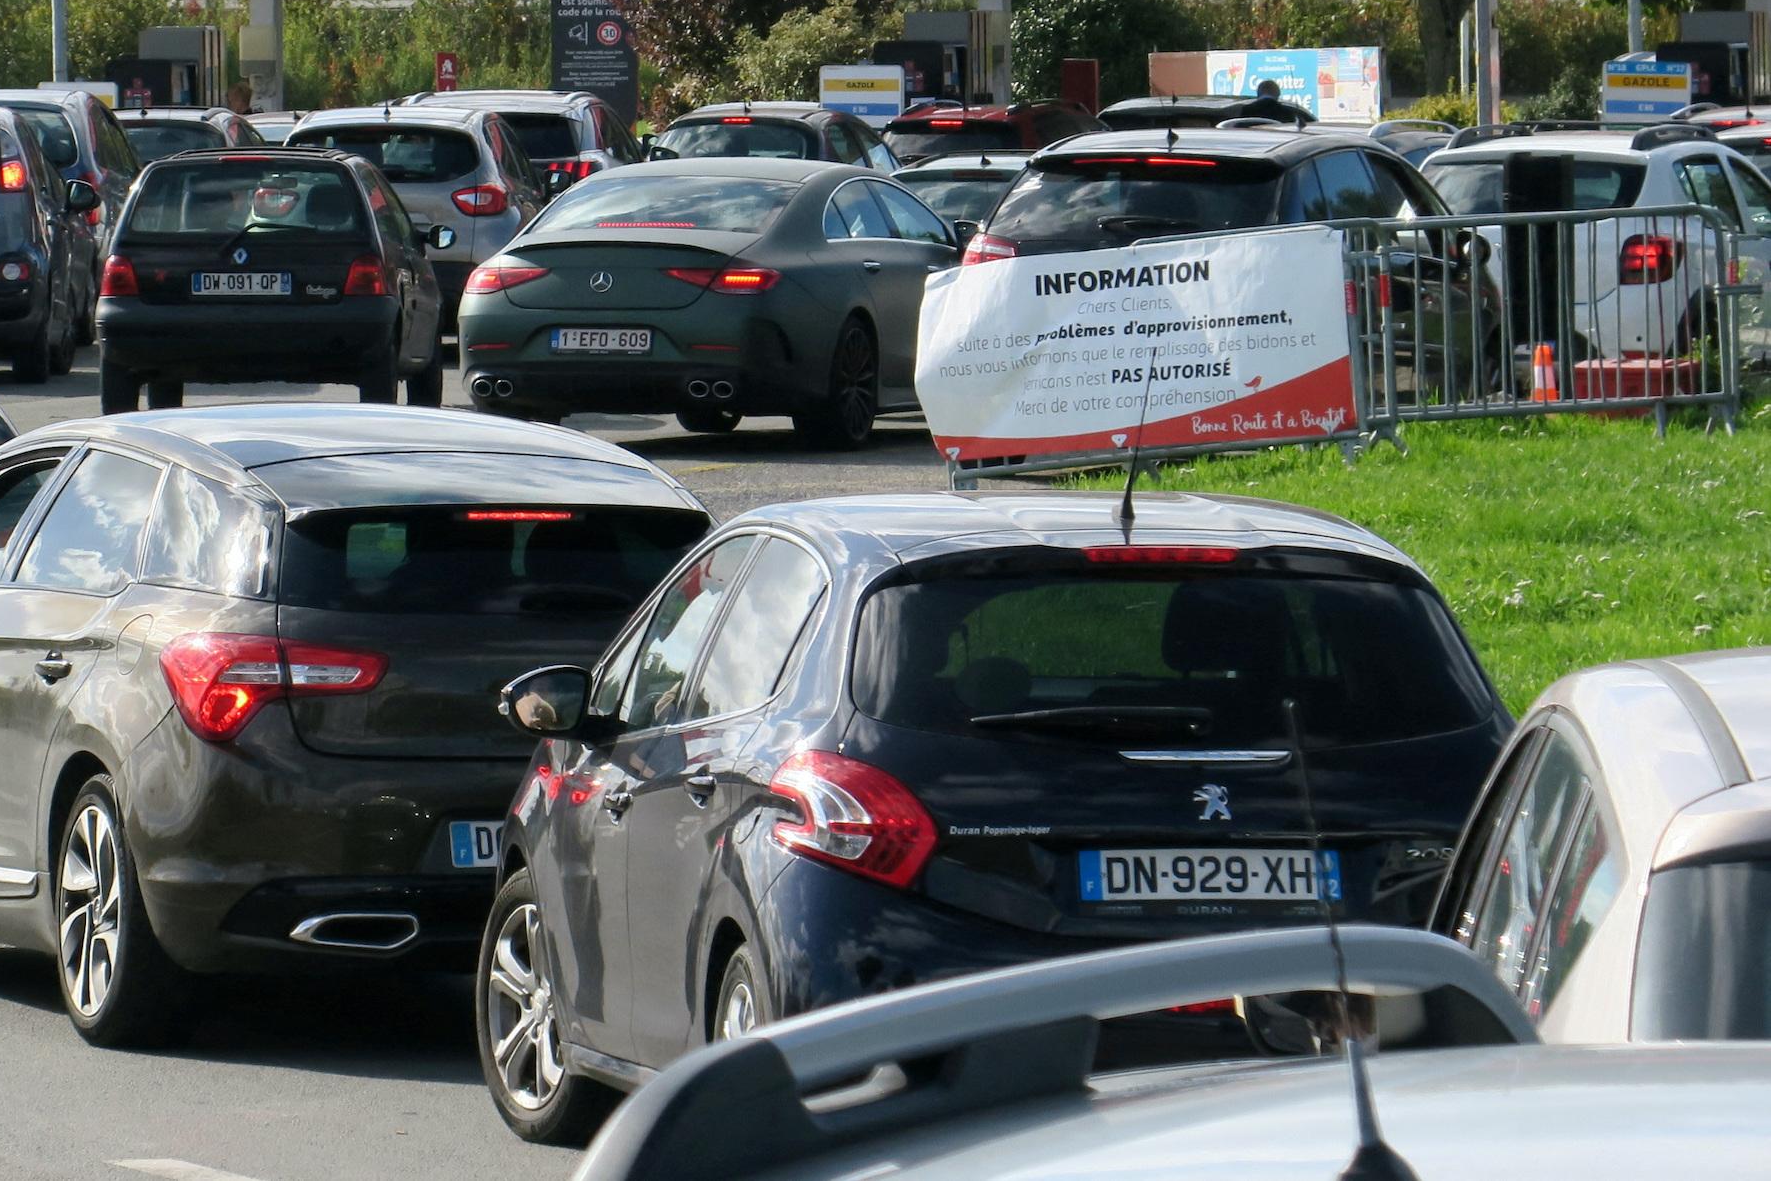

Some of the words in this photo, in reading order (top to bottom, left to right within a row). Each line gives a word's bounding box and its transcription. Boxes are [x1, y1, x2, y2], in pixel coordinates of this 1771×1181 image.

[557, 7, 580, 16] code
[581, 7, 593, 16] de
[595, 7, 603, 16] la
[603, 28, 616, 39] 30
[846, 81, 875, 89] GAZOLE
[1623, 76, 1670, 87] GAZOLE
[1035, 259, 1210, 297] INFORMATION
[1078, 298, 1117, 315] Chers
[1121, 297, 1173, 312] Clients,
[957, 337, 989, 353] suite
[992, 336, 1001, 349] à
[1005, 333, 1032, 349] des
[1035, 323, 1116, 347] problèmes
[939, 363, 973, 379] nous
[977, 359, 1008, 375] vous
[1011, 347, 1077, 372] informons
[1082, 348, 1108, 367] que
[1112, 345, 1126, 360] le
[1129, 339, 1215, 362] remplissage
[1218, 336, 1242, 353] des
[1246, 333, 1297, 351] bidons
[1300, 331, 1317, 347] et
[1111, 368, 1143, 384] PAS
[1148, 358, 1231, 383] AUTORISÉ
[1014, 399, 1047, 417] Merci
[1050, 397, 1068, 414] de
[1072, 396, 1111, 412] votre
[1115, 386, 1237, 410] compréhension
[1191, 415, 1228, 435] Bonne
[1233, 411, 1268, 435] Route
[1272, 409, 1285, 429] et
[949, 825, 981, 835] Duran
[459, 849, 468, 859] F
[1086, 881, 1095, 893] F
[1104, 855, 1314, 895] DN-929-XH
[1178, 905, 1233, 916] DURAN
